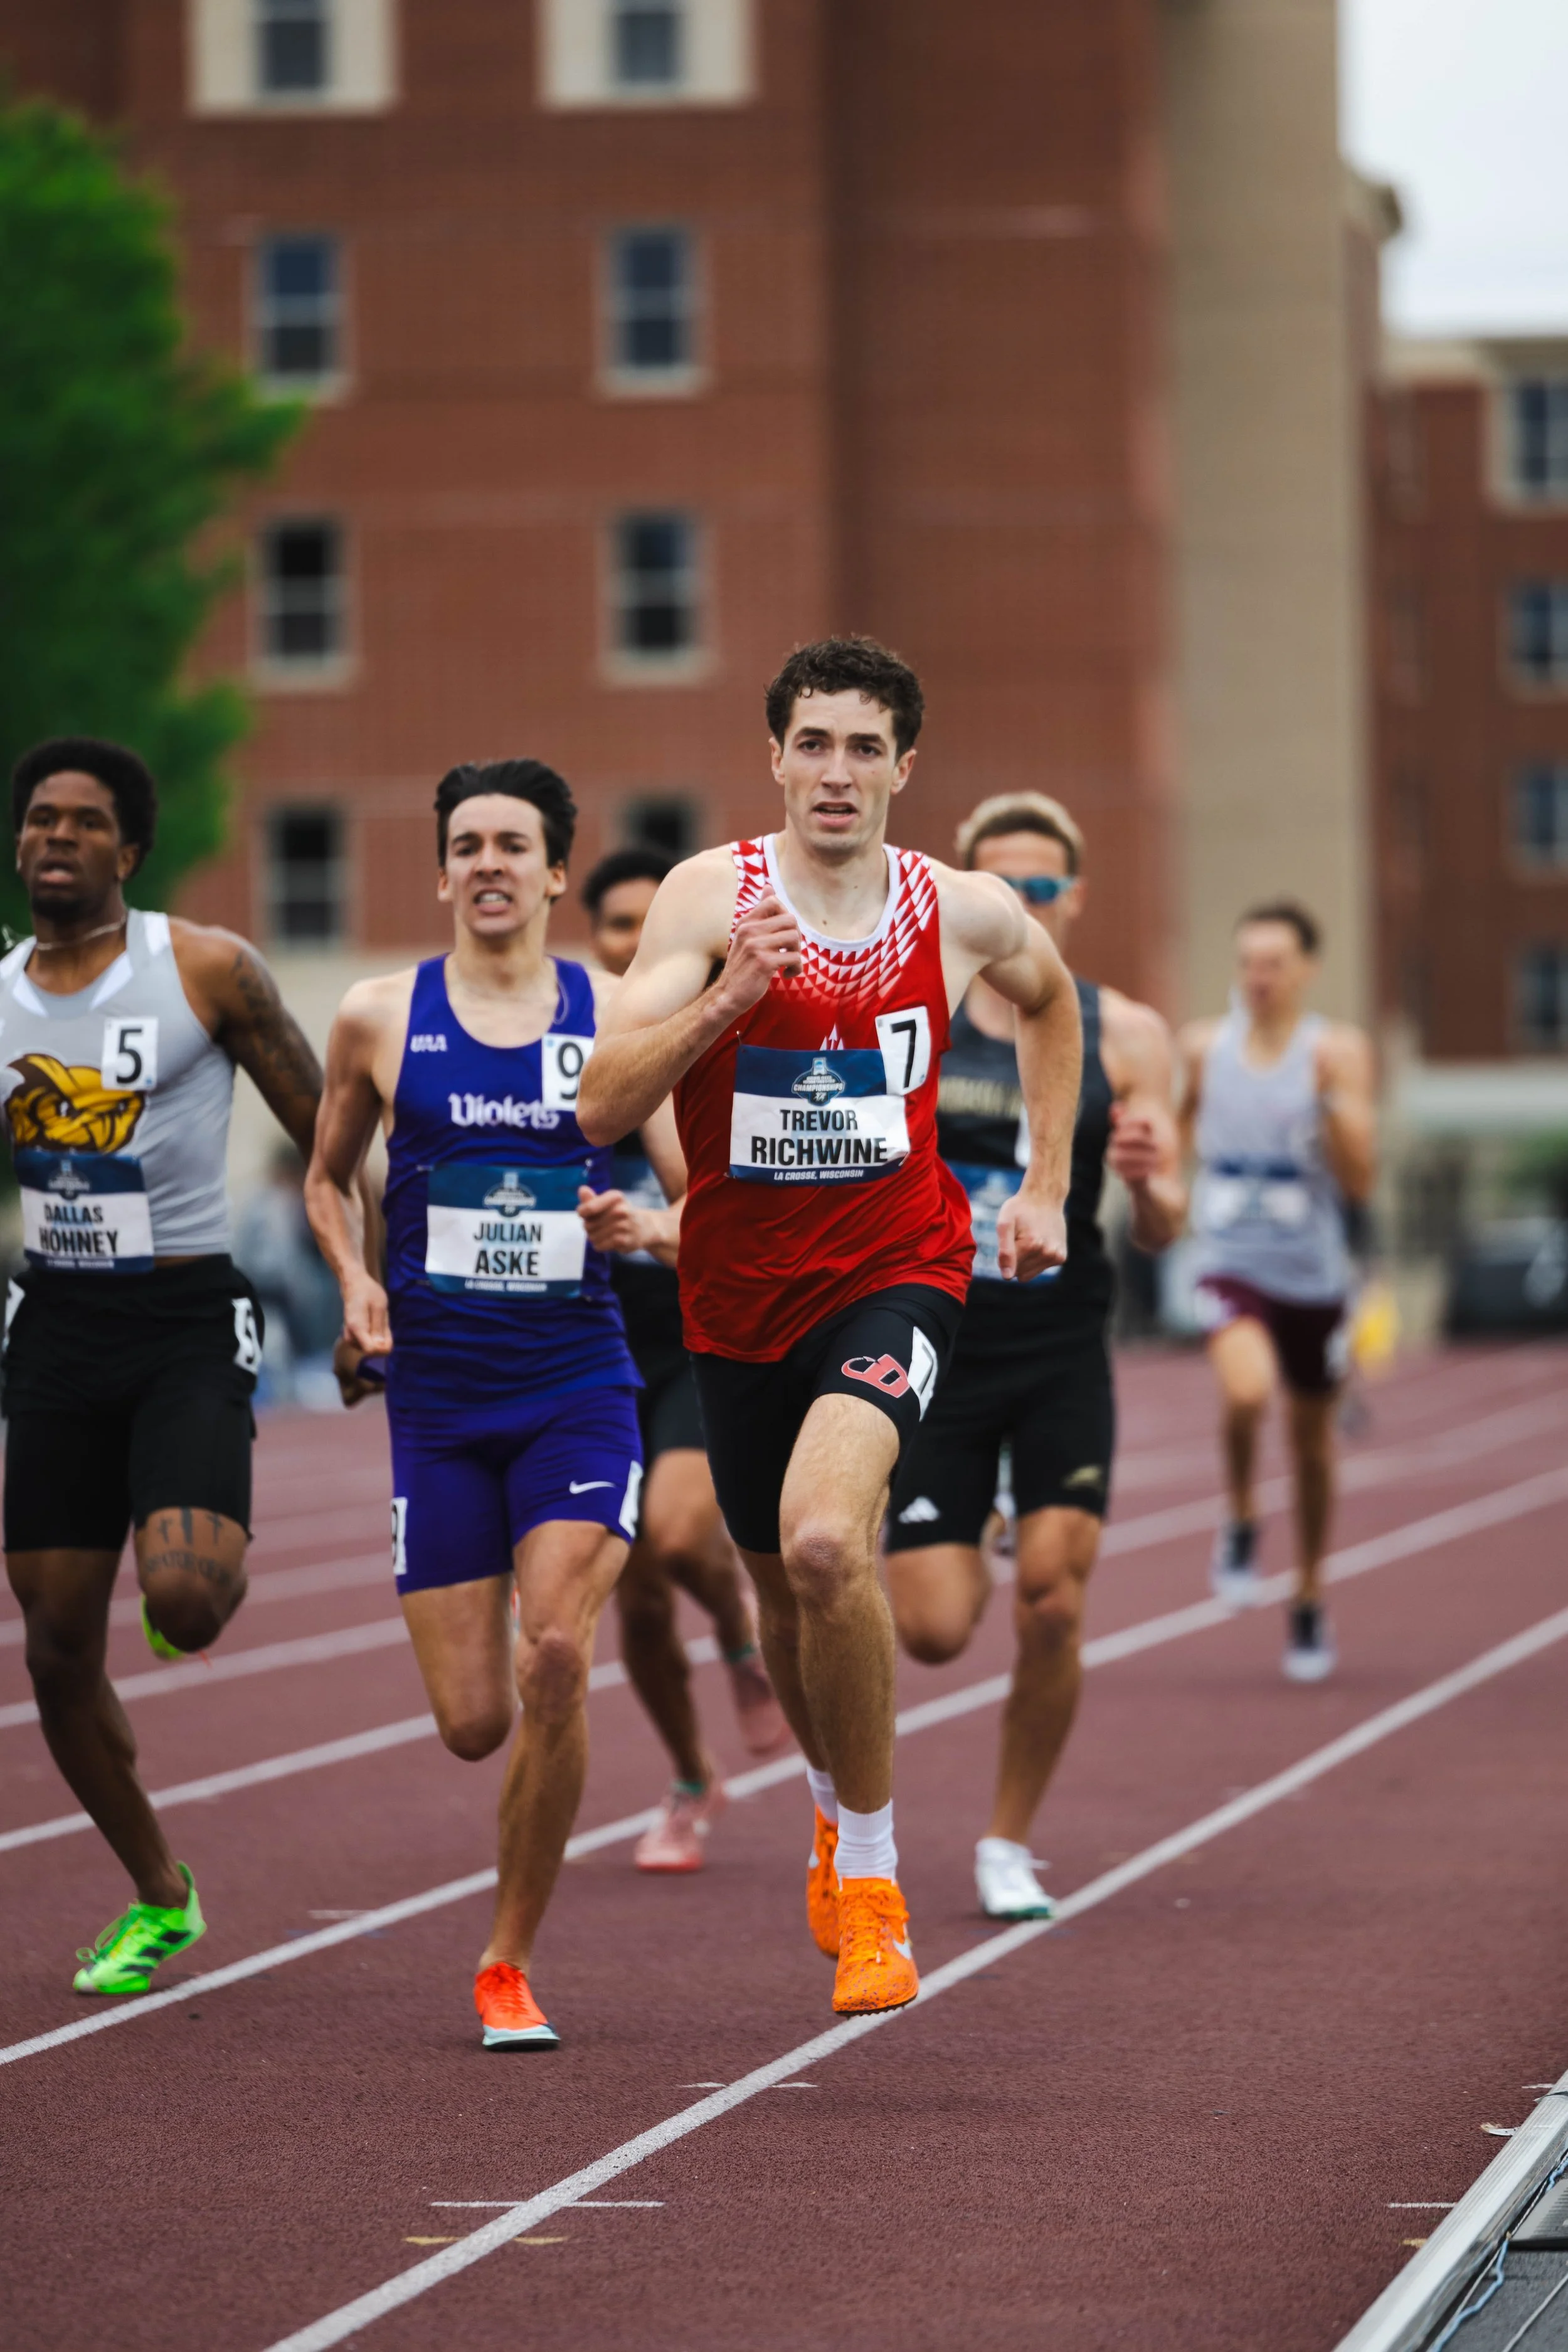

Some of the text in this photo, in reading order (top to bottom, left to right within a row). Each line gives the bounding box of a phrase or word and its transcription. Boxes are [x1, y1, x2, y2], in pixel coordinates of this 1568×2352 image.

[116, 1028, 142, 1084] 5
[891, 1019, 916, 1088] 7
[558, 1042, 583, 1100] 9
[793, 1083, 844, 1092] CHAMPIONSHIPS
[448, 1093, 560, 1130] Violets
[780, 1110, 858, 1131] TREVOR
[751, 1136, 888, 1165] RICHWINE
[774, 1169, 864, 1180] LA CROSSE, WISCONSIN
[45, 1204, 103, 1224] DALLAS
[40, 1227, 118, 1255] HOHNEY
[474, 1222, 543, 1242] JULIAN
[475, 1251, 539, 1276] ASKE
